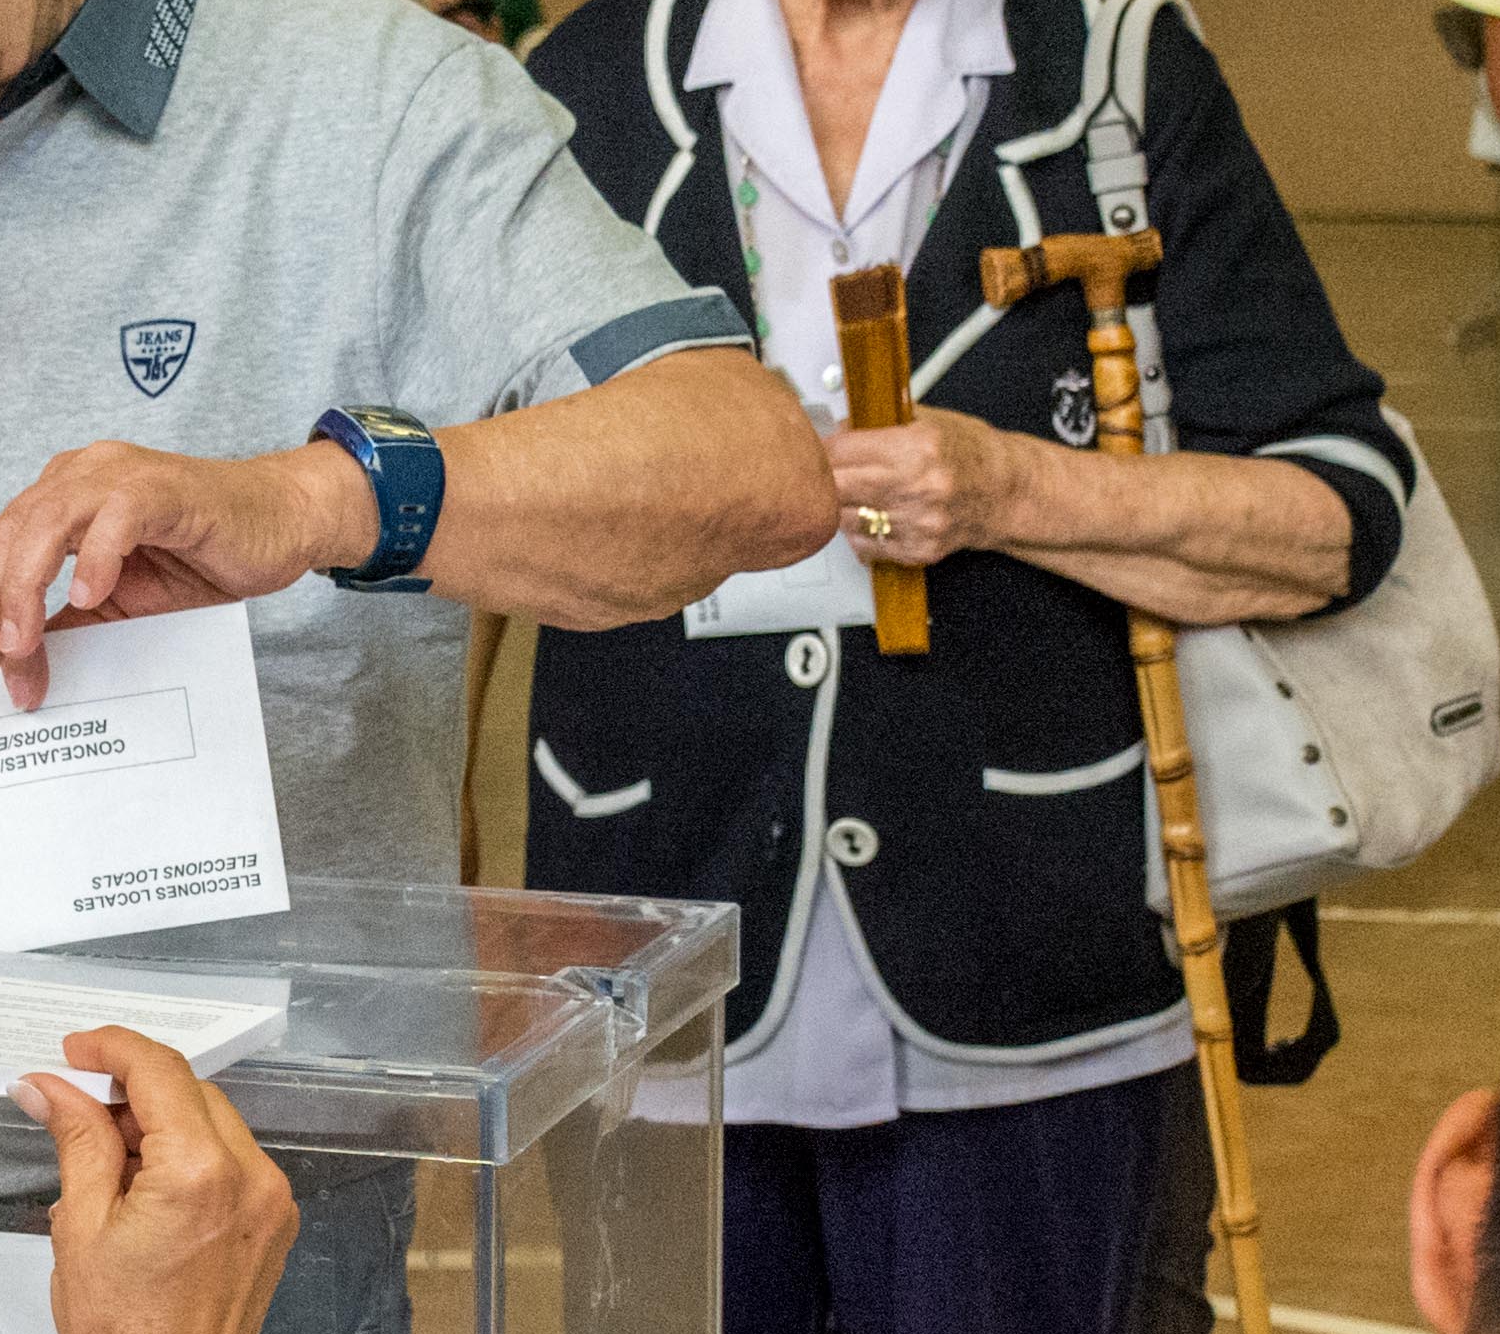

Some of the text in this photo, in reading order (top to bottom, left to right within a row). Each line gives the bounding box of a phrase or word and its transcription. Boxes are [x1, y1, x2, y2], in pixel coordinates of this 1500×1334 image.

[135, 329, 183, 346] JEANS
[91, 853, 258, 890] ELECCIONS LOCALS
[72, 873, 262, 913] ELECCIONES LOCALES
